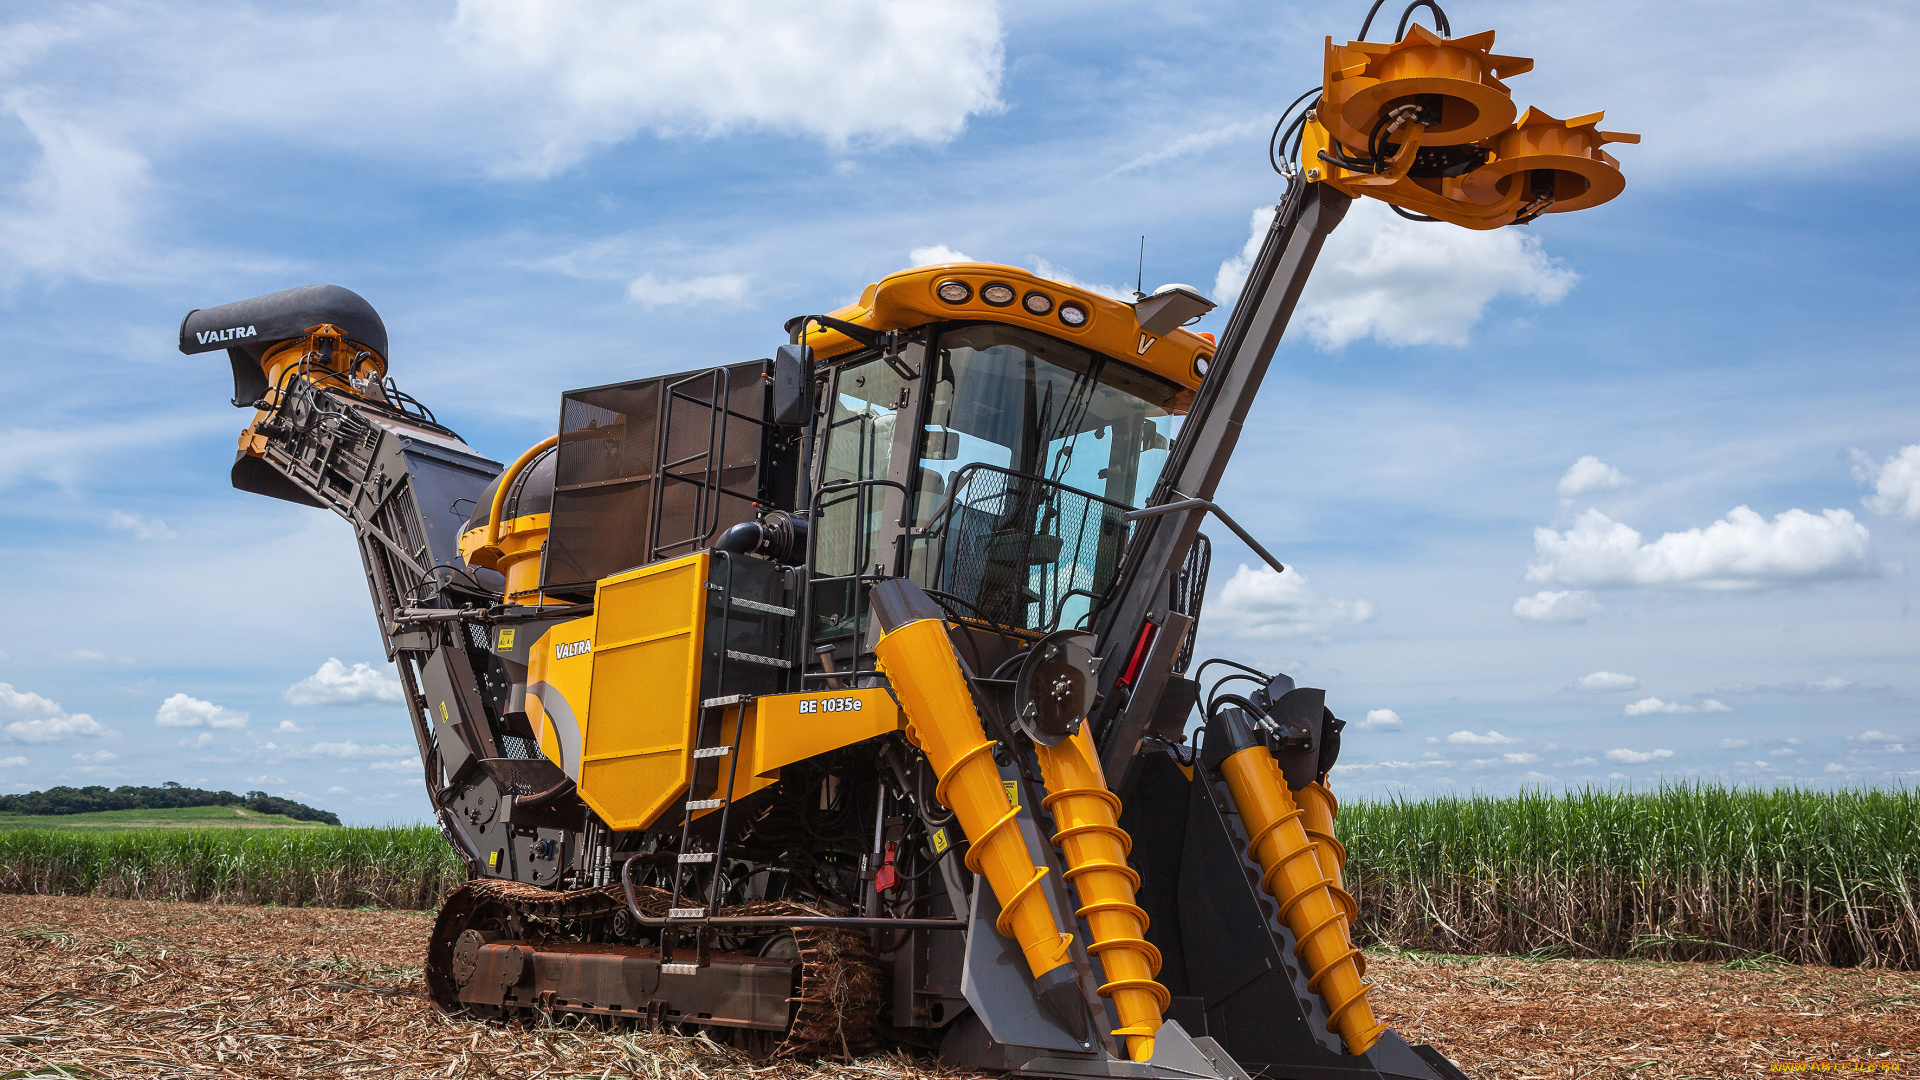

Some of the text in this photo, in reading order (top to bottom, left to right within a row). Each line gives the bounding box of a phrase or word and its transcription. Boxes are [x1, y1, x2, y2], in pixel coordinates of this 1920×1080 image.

[195, 324, 258, 345] VALTRA
[1137, 332, 1157, 356] V
[555, 639, 591, 660] VALTRA
[799, 697, 862, 714] BE 1035e
